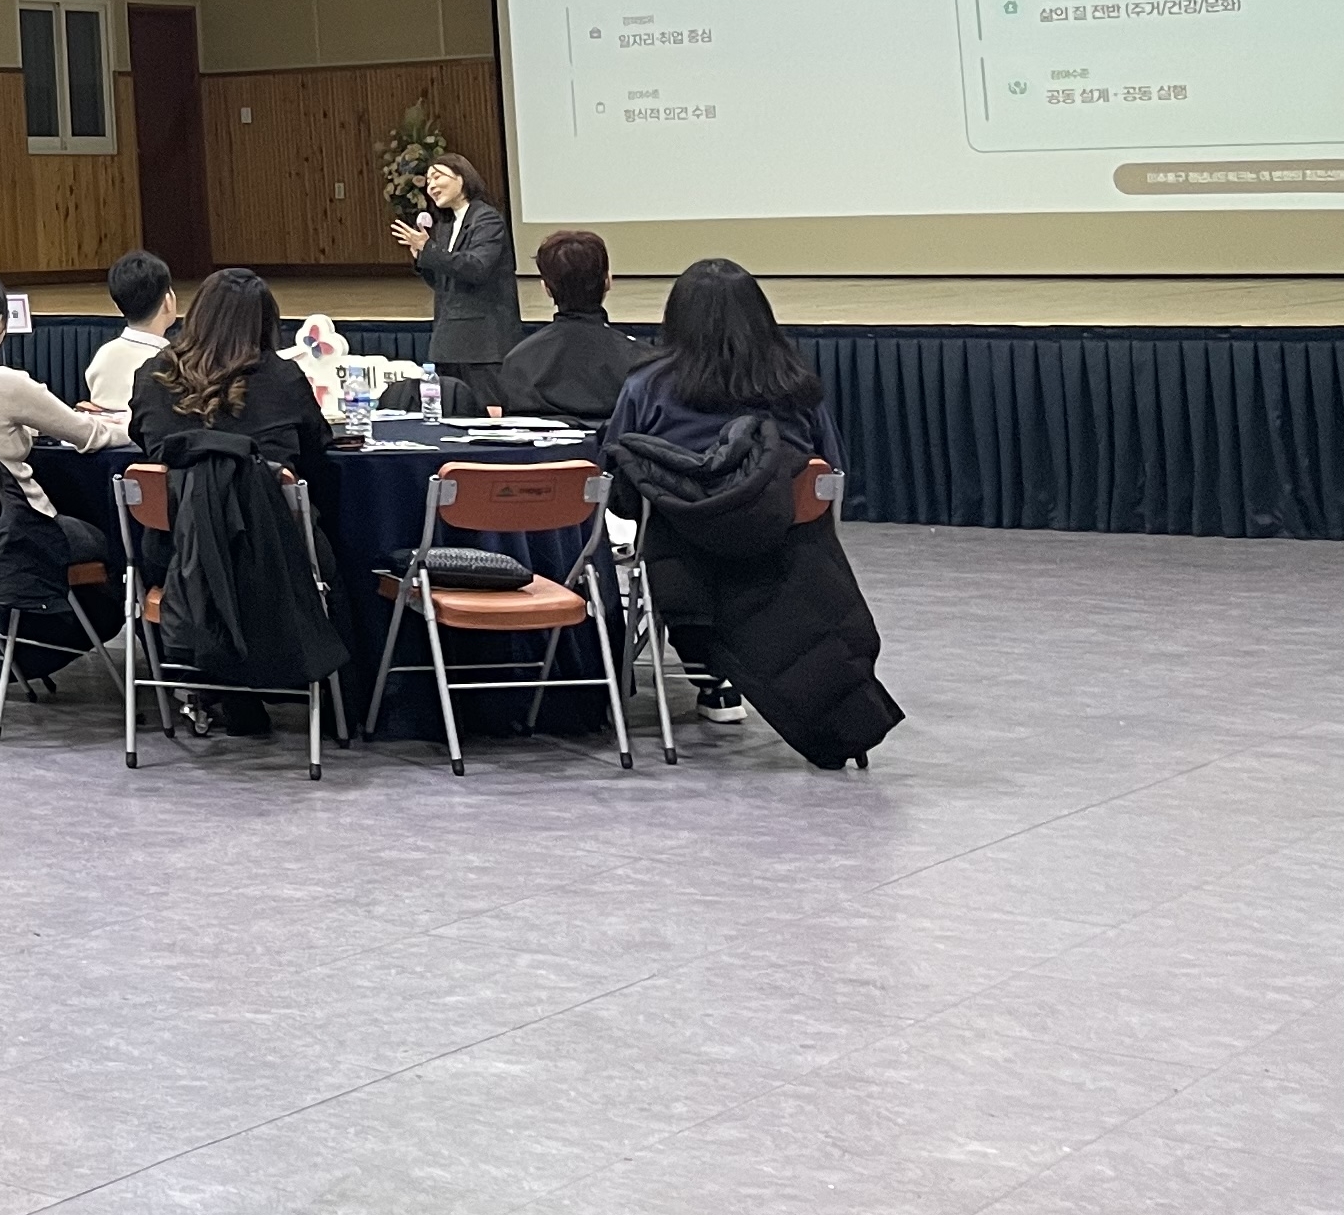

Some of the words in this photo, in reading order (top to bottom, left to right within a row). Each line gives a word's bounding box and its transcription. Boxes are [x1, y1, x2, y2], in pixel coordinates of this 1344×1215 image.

[1040, 6, 1069, 22] 삶의
[1072, 5, 1087, 21] 질
[1091, 3, 1121, 20] 전반
[687, 28, 712, 43] 중심
[1045, 88, 1075, 105] 공동
[1080, 87, 1110, 103] 설계
[1122, 86, 1152, 102] 공동
[1157, 84, 1188, 101] 실행
[624, 108, 660, 123] 형식적
